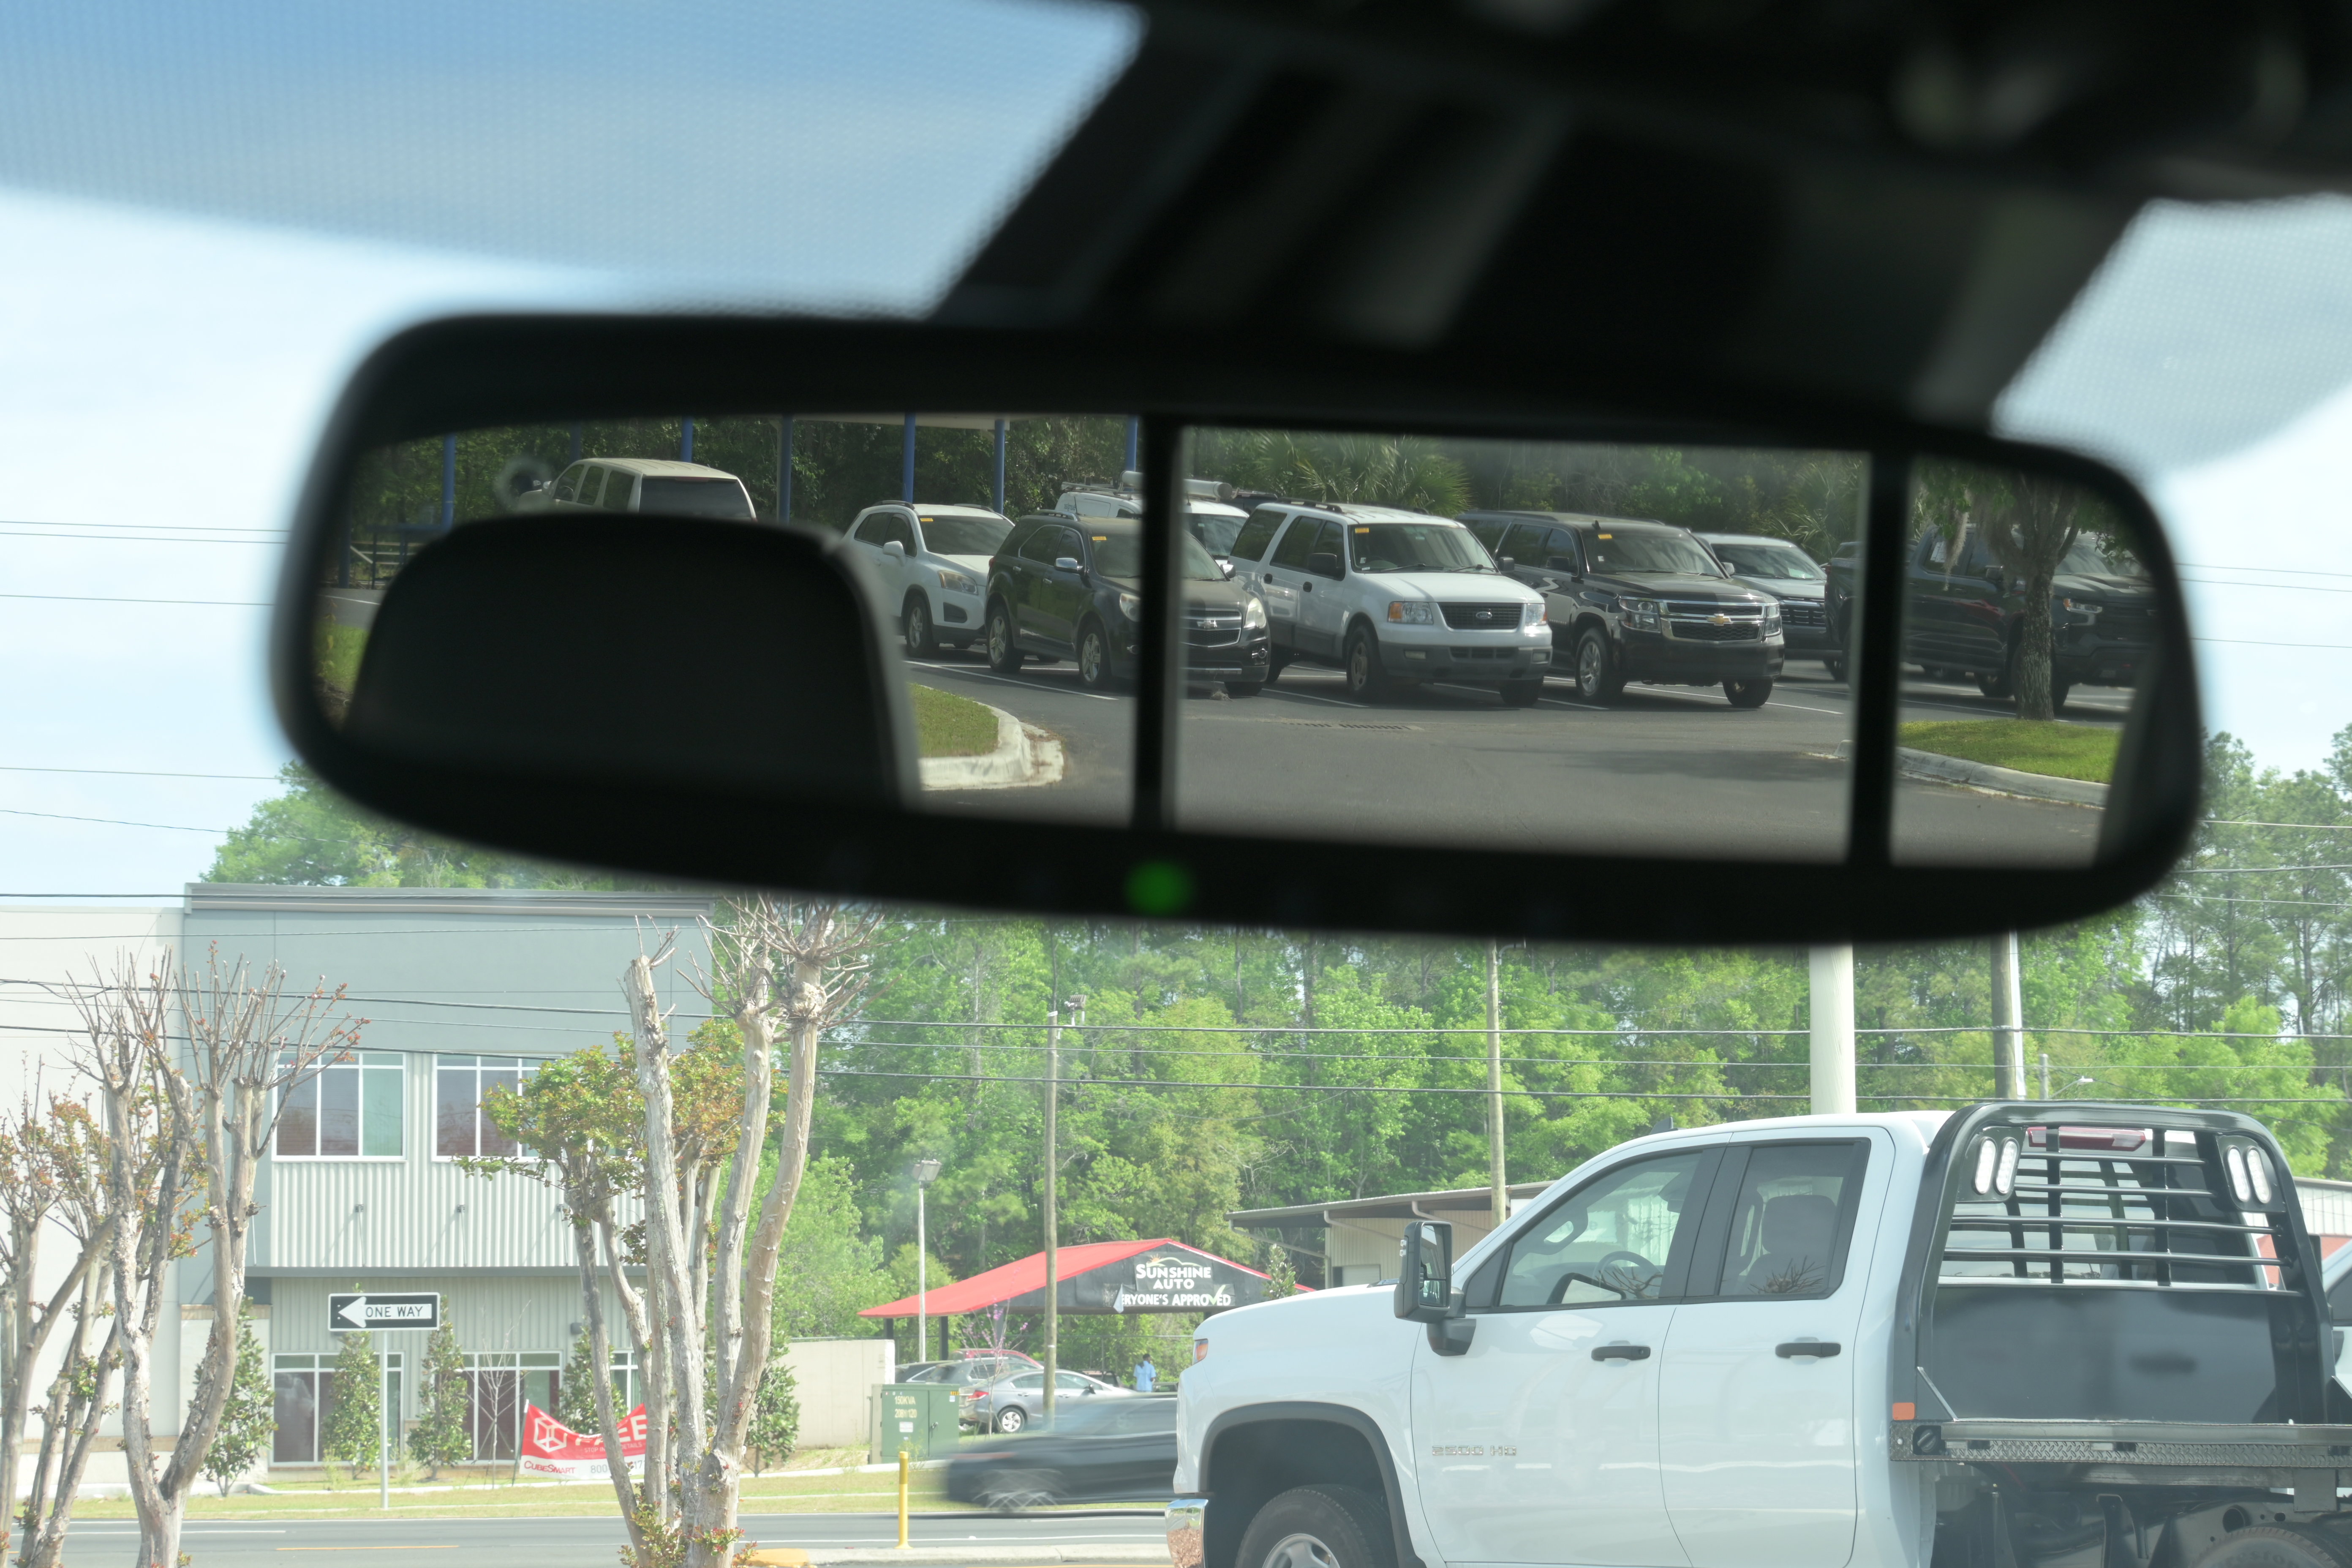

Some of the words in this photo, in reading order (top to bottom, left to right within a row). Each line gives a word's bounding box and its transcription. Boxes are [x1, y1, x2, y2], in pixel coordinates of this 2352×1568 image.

[1136, 1264, 1211, 1279] SUNSHINE
[1153, 1279, 1195, 1289] AUTO
[366, 1307, 392, 1318] ONE
[397, 1306, 423, 1317] WAY
[894, 1396, 916, 1405] 150KVA
[1432, 1446, 1484, 1456] 2500
[1490, 1446, 1516, 1456] HD
